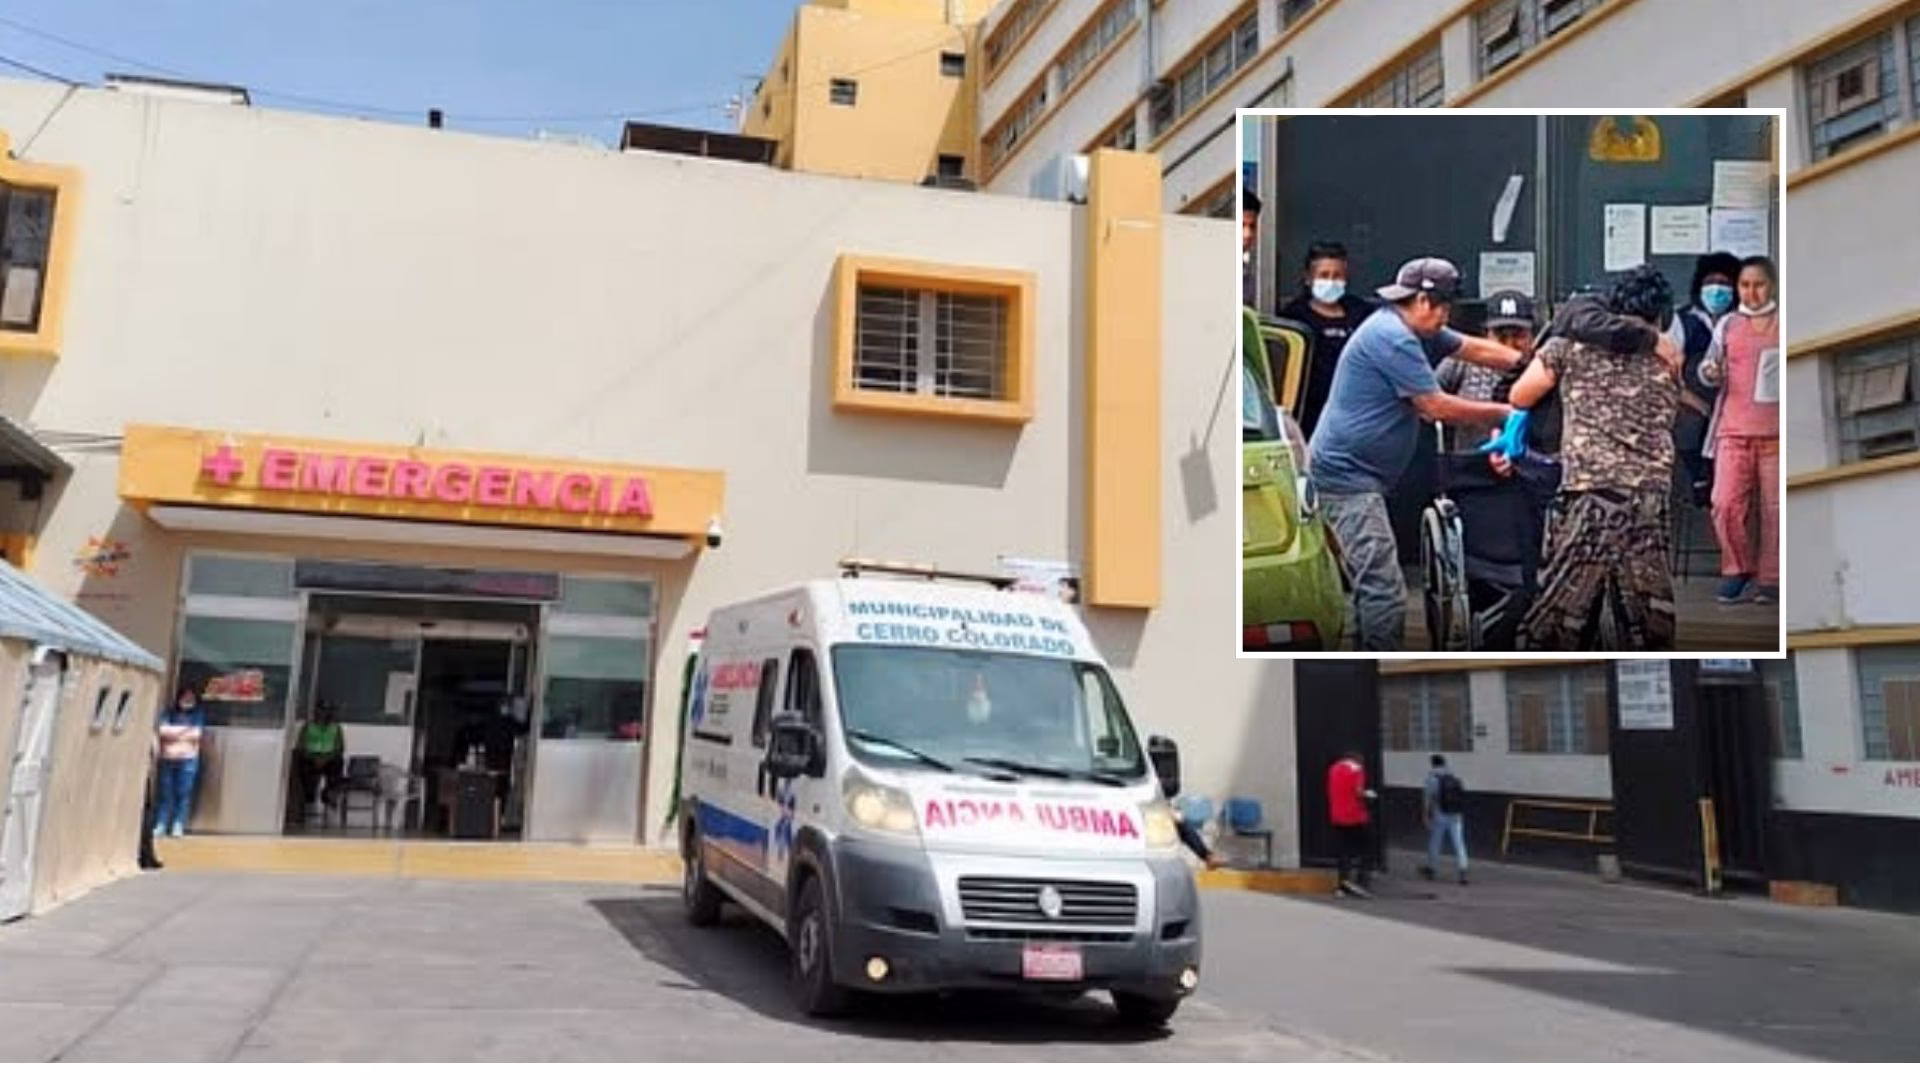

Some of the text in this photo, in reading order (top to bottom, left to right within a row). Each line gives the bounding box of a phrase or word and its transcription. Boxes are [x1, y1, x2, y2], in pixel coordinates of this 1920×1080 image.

[1500, 298, 1517, 315] M
[260, 450, 654, 516] EMERGENCIA
[849, 602, 1070, 632] MUNICIPALIDAD DE
[857, 623, 1075, 656] CERRO COLORADO
